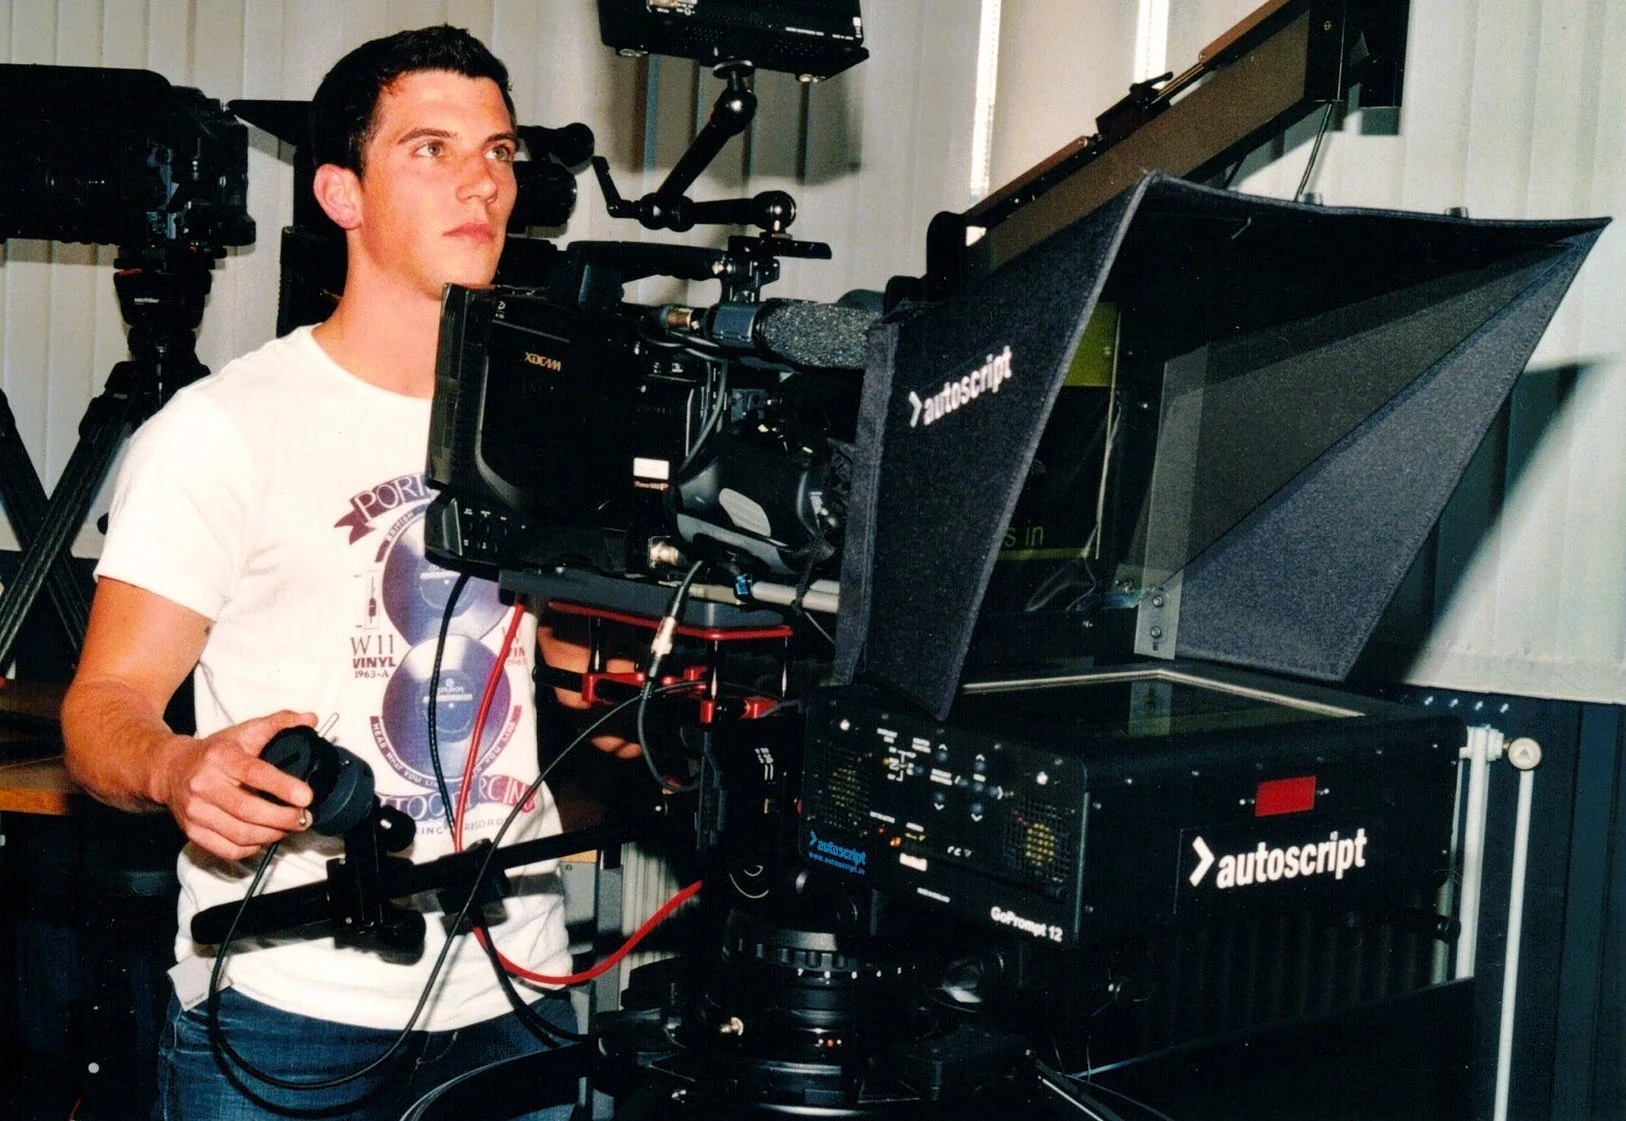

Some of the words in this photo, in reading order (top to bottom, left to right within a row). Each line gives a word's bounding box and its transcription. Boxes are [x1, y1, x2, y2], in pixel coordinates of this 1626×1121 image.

[525, 351, 562, 372] XDCAM
[923, 345, 1012, 426] autoscript
[1025, 519, 1045, 547] in
[353, 656, 397, 669] VINYL
[403, 769, 423, 784] YOU
[1216, 827, 1368, 890] autoscript
[990, 905, 1047, 937] GoPrompt
[1048, 925, 1063, 942] 12
